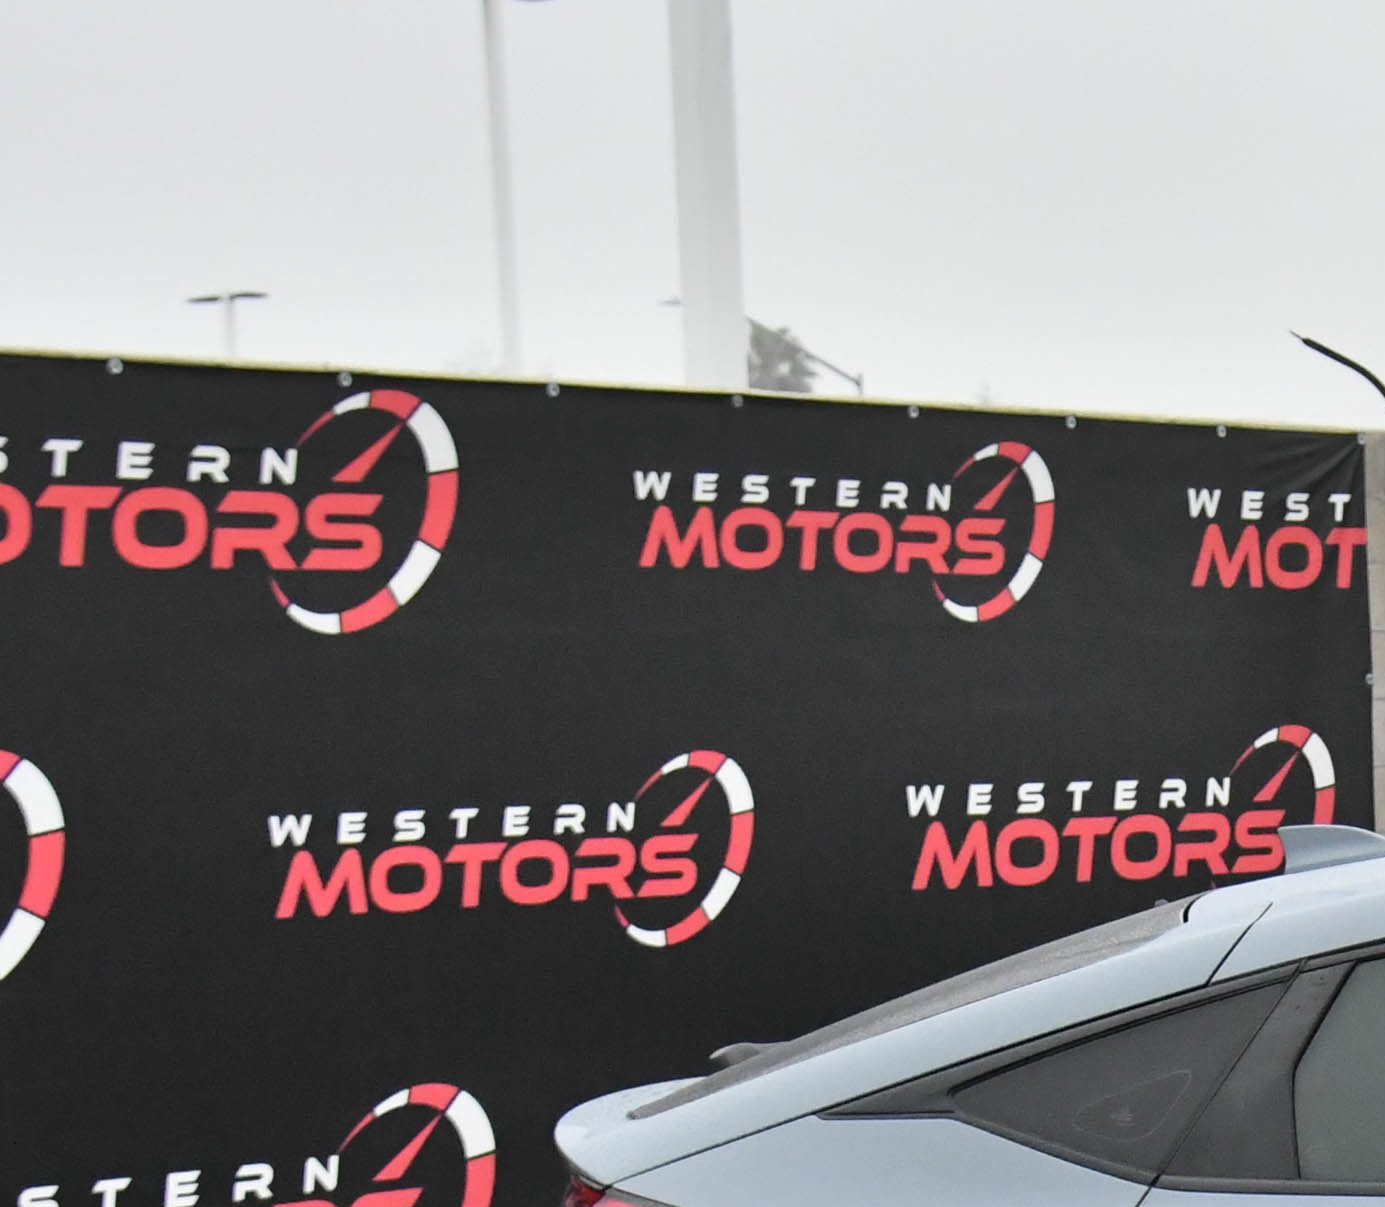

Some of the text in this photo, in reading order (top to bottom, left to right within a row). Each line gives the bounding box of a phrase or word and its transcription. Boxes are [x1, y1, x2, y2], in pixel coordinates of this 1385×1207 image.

[0, 436, 298, 485] TERN
[632, 470, 952, 512] WESTERN
[1187, 487, 1352, 522] WEST
[638, 505, 1006, 576] MOTORS
[1191, 523, 1369, 590] MOT
[905, 776, 1231, 818] WESTERN
[267, 801, 636, 847] WESTERN
[911, 809, 1287, 891] MOTORS
[275, 833, 699, 919] MOTORS
